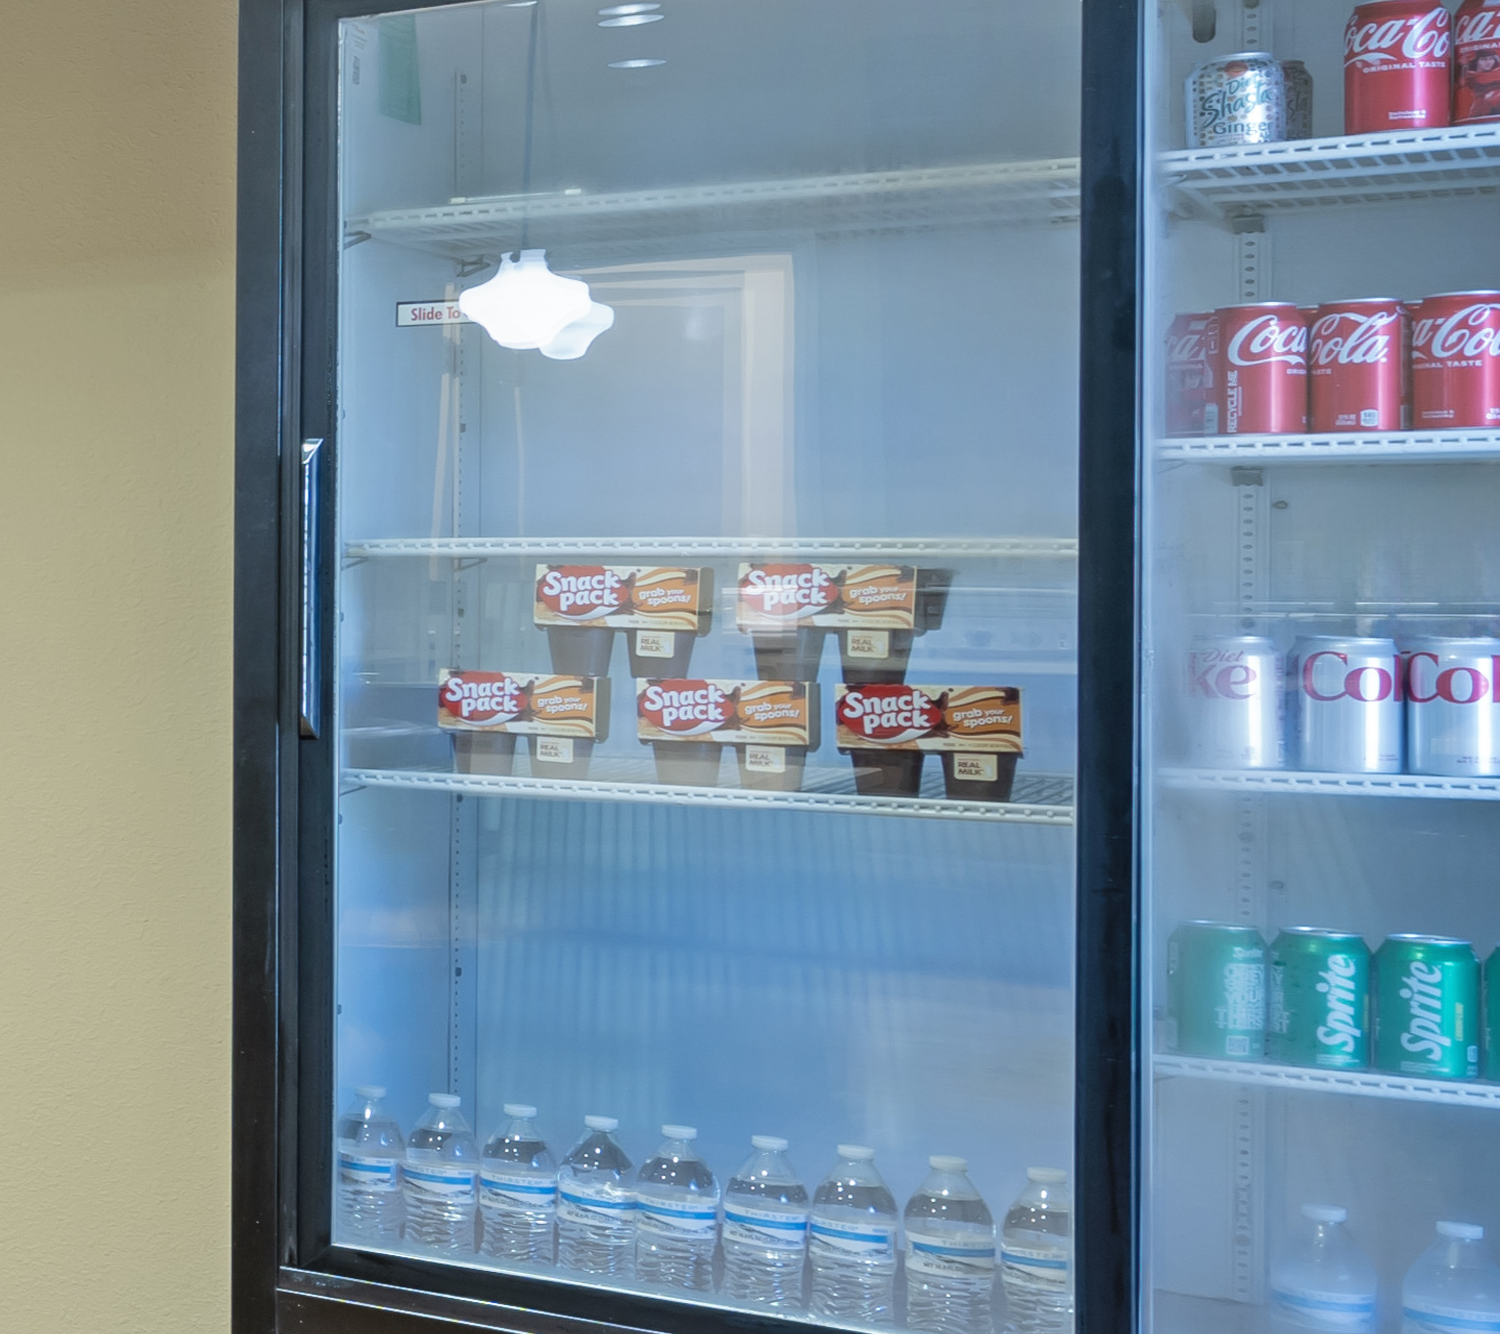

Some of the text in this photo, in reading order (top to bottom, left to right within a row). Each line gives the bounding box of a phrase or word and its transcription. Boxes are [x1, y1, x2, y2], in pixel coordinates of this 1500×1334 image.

[1200, 84, 1275, 128] Shasta
[1213, 119, 1273, 136] Ginger
[411, 306, 461, 321] Slide To
[543, 570, 621, 597] Snack
[743, 568, 830, 595] Snack
[849, 585, 877, 598] grab
[559, 588, 619, 611] pack
[638, 587, 665, 601] grab
[646, 594, 691, 607] spoons!
[764, 587, 829, 611] pack
[858, 593, 907, 605] spoons!
[445, 677, 520, 702] Snack
[644, 684, 726, 711] Snack
[461, 696, 519, 717] pack
[537, 695, 562, 708] grab
[546, 702, 588, 714] spoons!
[744, 701, 772, 715] grab
[843, 690, 931, 719] Snack
[662, 703, 725, 727] pack
[754, 709, 800, 721] spoons!
[863, 711, 931, 735] pack
[953, 708, 983, 721] grab
[963, 715, 1012, 728] spoons!
[1316, 954, 1362, 1053] Sprite
[1399, 961, 1451, 1061] Sprite
